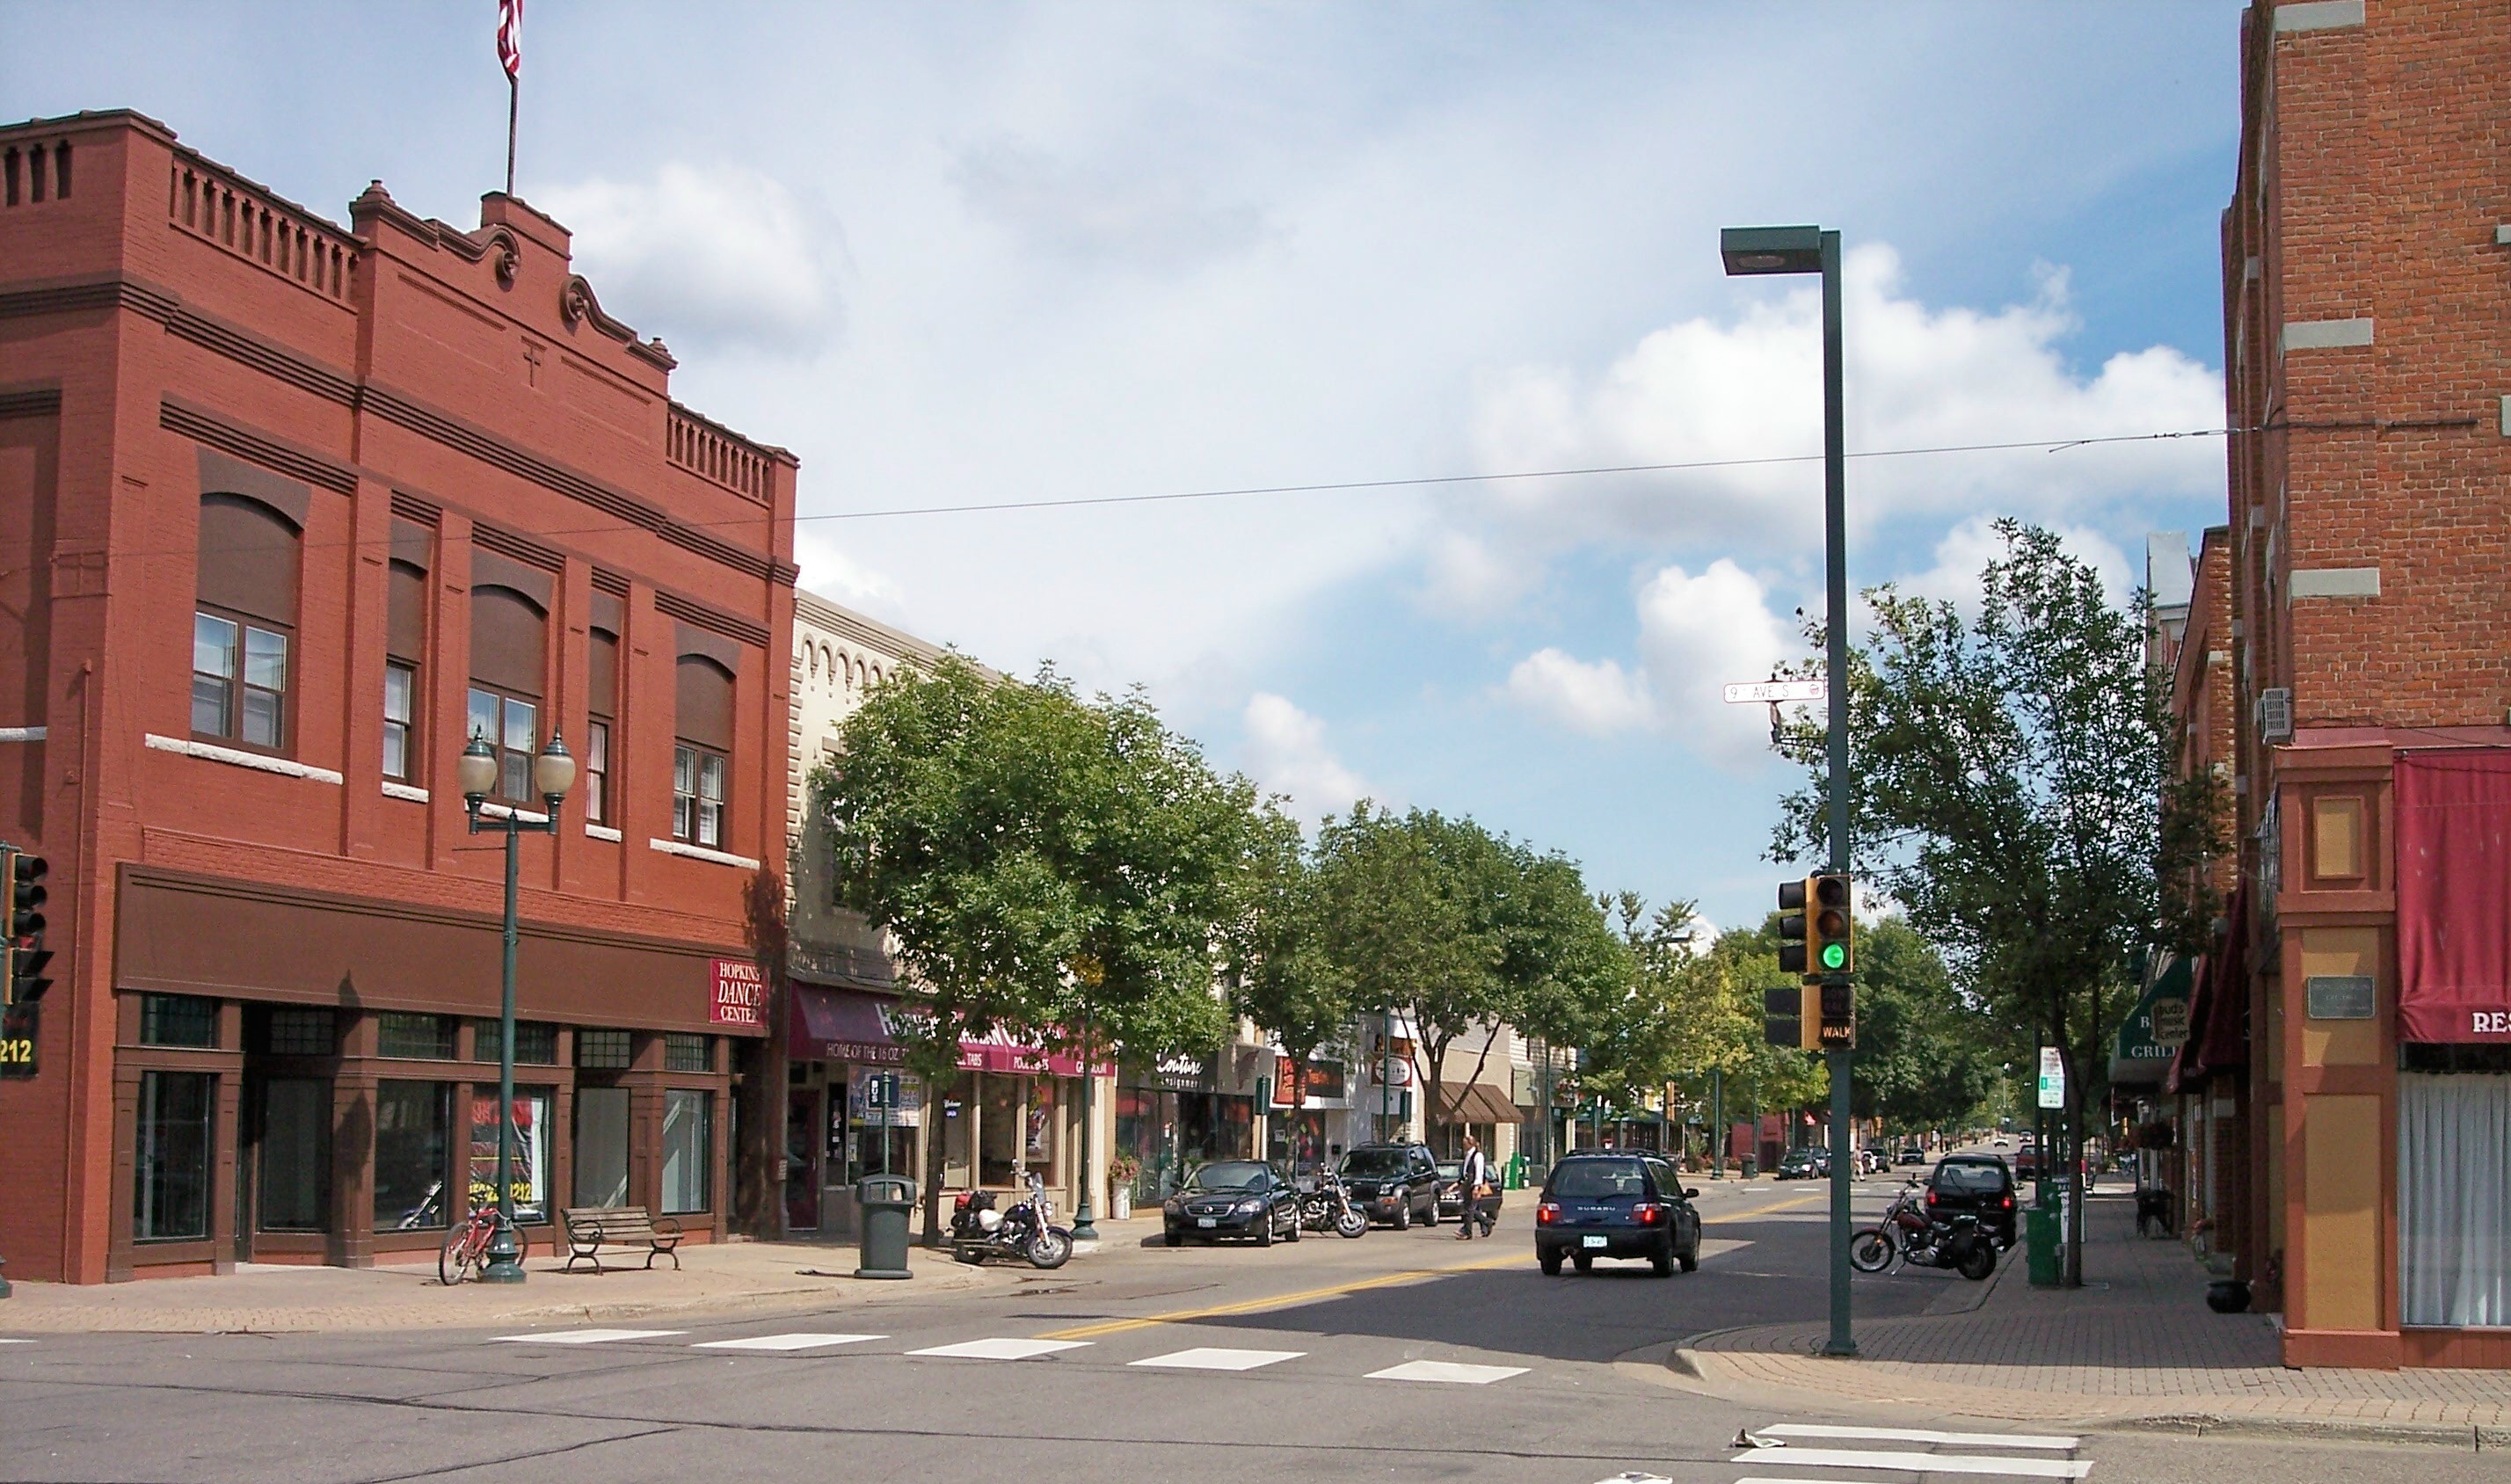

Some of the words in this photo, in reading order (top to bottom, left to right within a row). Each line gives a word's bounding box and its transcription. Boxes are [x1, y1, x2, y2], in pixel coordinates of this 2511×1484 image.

[1753, 686, 1774, 698] AVE
[1782, 685, 1789, 697] S
[719, 962, 760, 981] HOPKINS
[717, 980, 761, 1007] DANCE
[720, 1006, 757, 1022] CENTER
[2472, 1012, 2511, 1032] RE
[1823, 1026, 1851, 1037] WALK
[826, 1043, 850, 1058] HOME
[851, 1044, 861, 1058] OF
[862, 1045, 877, 1059] THE
[967, 1053, 982, 1066] TABS
